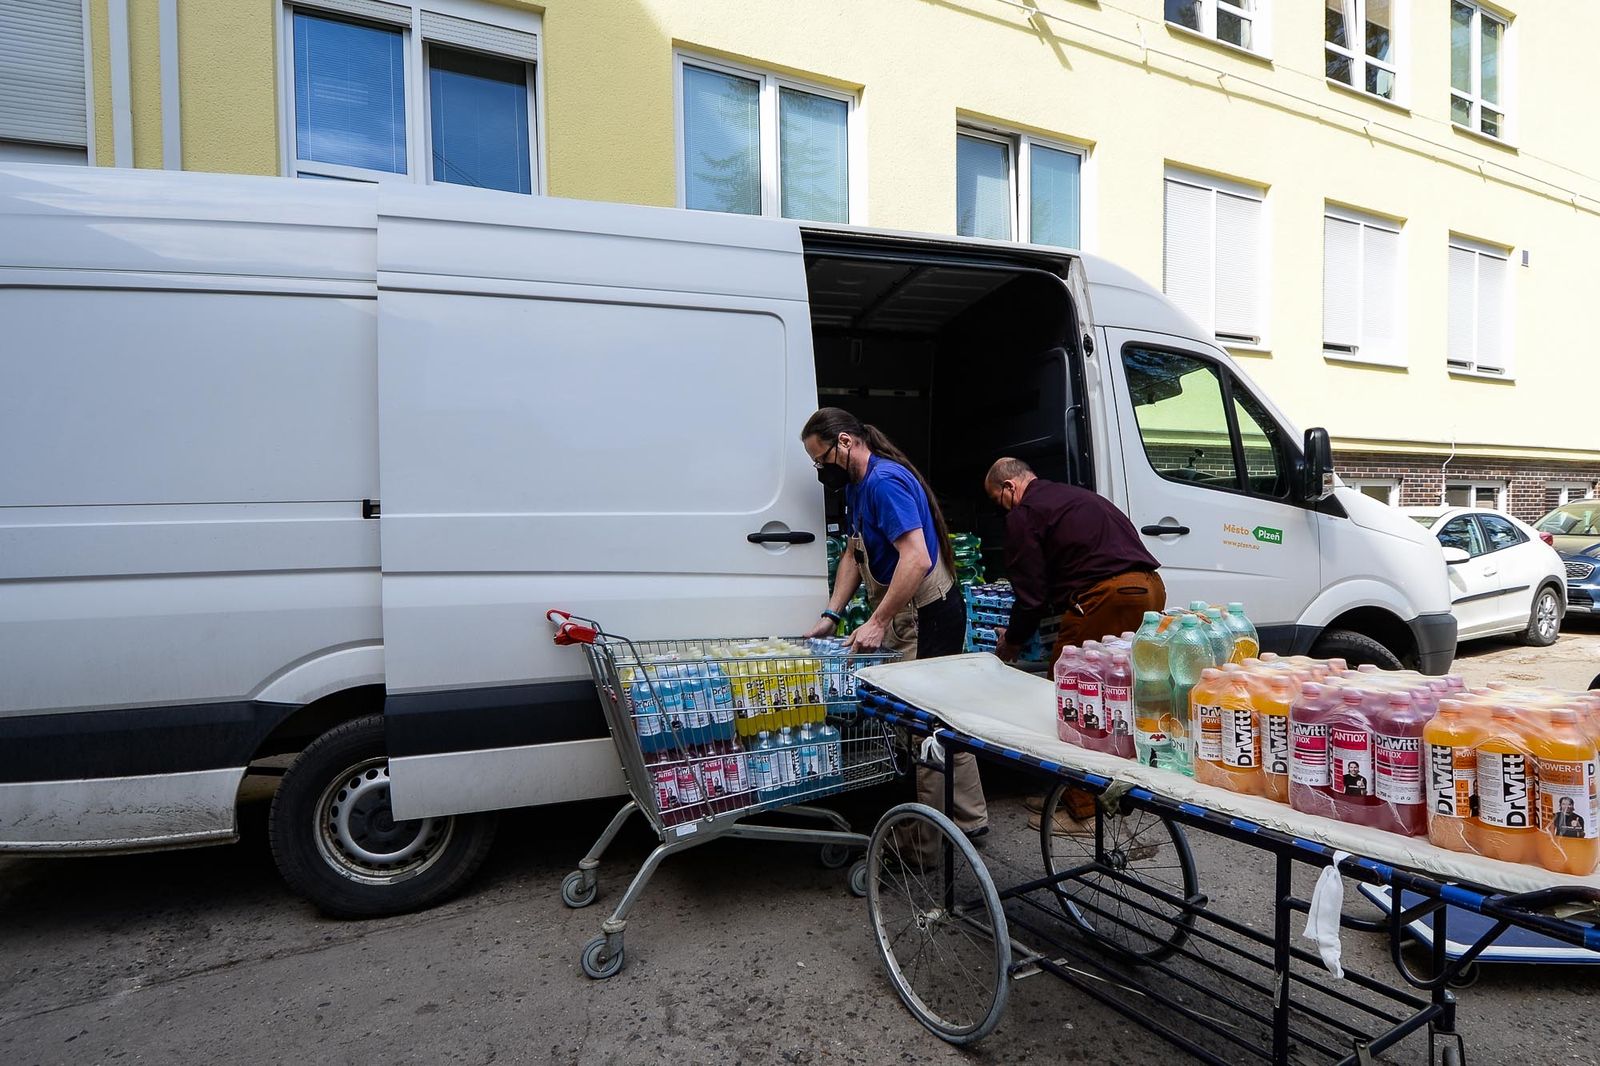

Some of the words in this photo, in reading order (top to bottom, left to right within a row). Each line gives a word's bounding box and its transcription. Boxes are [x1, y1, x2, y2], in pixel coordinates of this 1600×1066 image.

[1223, 523, 1250, 536] Město
[1258, 529, 1280, 541] Plzeň
[1234, 710, 1252, 766] DrWitt
[1269, 715, 1288, 774] DrWitt
[1334, 732, 1366, 742] ANTIOX
[1377, 736, 1418, 750] DrWitt
[1432, 744, 1454, 815] DrWitt
[1540, 762, 1581, 773] POWER-C
[1502, 754, 1526, 826] DrWitt
